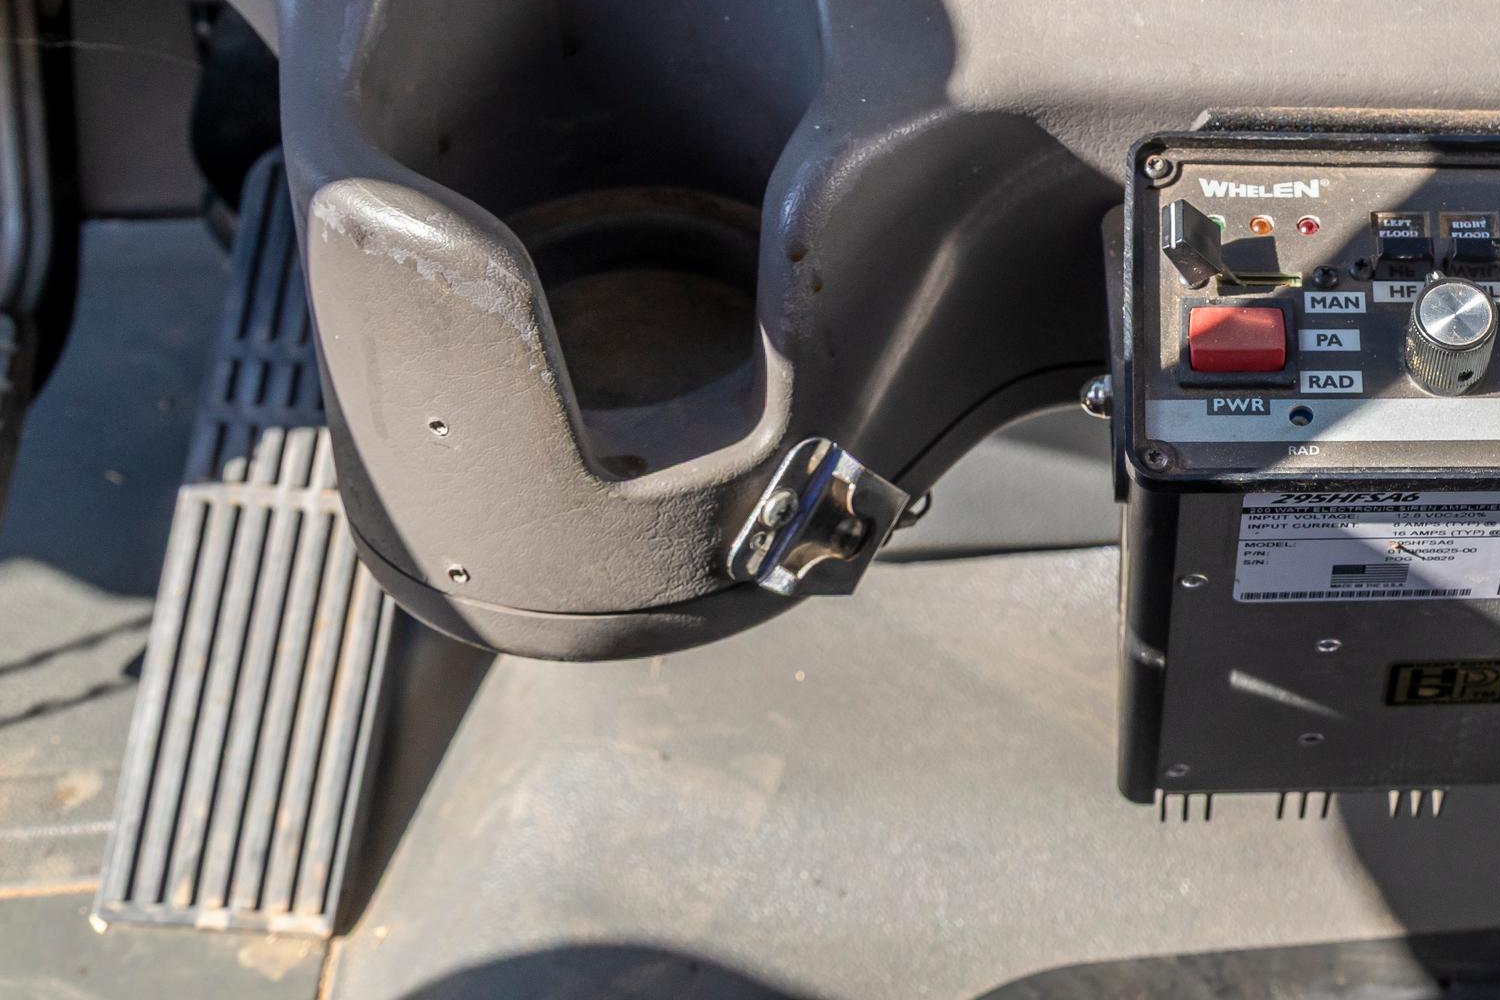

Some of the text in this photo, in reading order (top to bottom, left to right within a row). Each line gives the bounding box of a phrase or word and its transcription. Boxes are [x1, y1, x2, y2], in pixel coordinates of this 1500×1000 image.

[1198, 178, 1321, 199] WHELEN
[1383, 219, 1412, 227] LEFT
[1452, 219, 1487, 229] RIGHT
[1379, 230, 1419, 238] FLOOD
[1451, 231, 1490, 239] FLOOD
[1389, 285, 1418, 298] HF
[1310, 296, 1361, 310] MAN
[1316, 333, 1344, 347] PA
[1308, 375, 1355, 389] RAD
[1212, 398, 1265, 412] PWR
[1287, 445, 1320, 456] RAD
[1271, 492, 1420, 504] 295HFSA6
[1313, 505, 1395, 513] ELECTRONIC
[1404, 520, 1441, 528] AMPS
[1445, 520, 1480, 528] (TYP)
[1450, 529, 1486, 537] (TYP)
